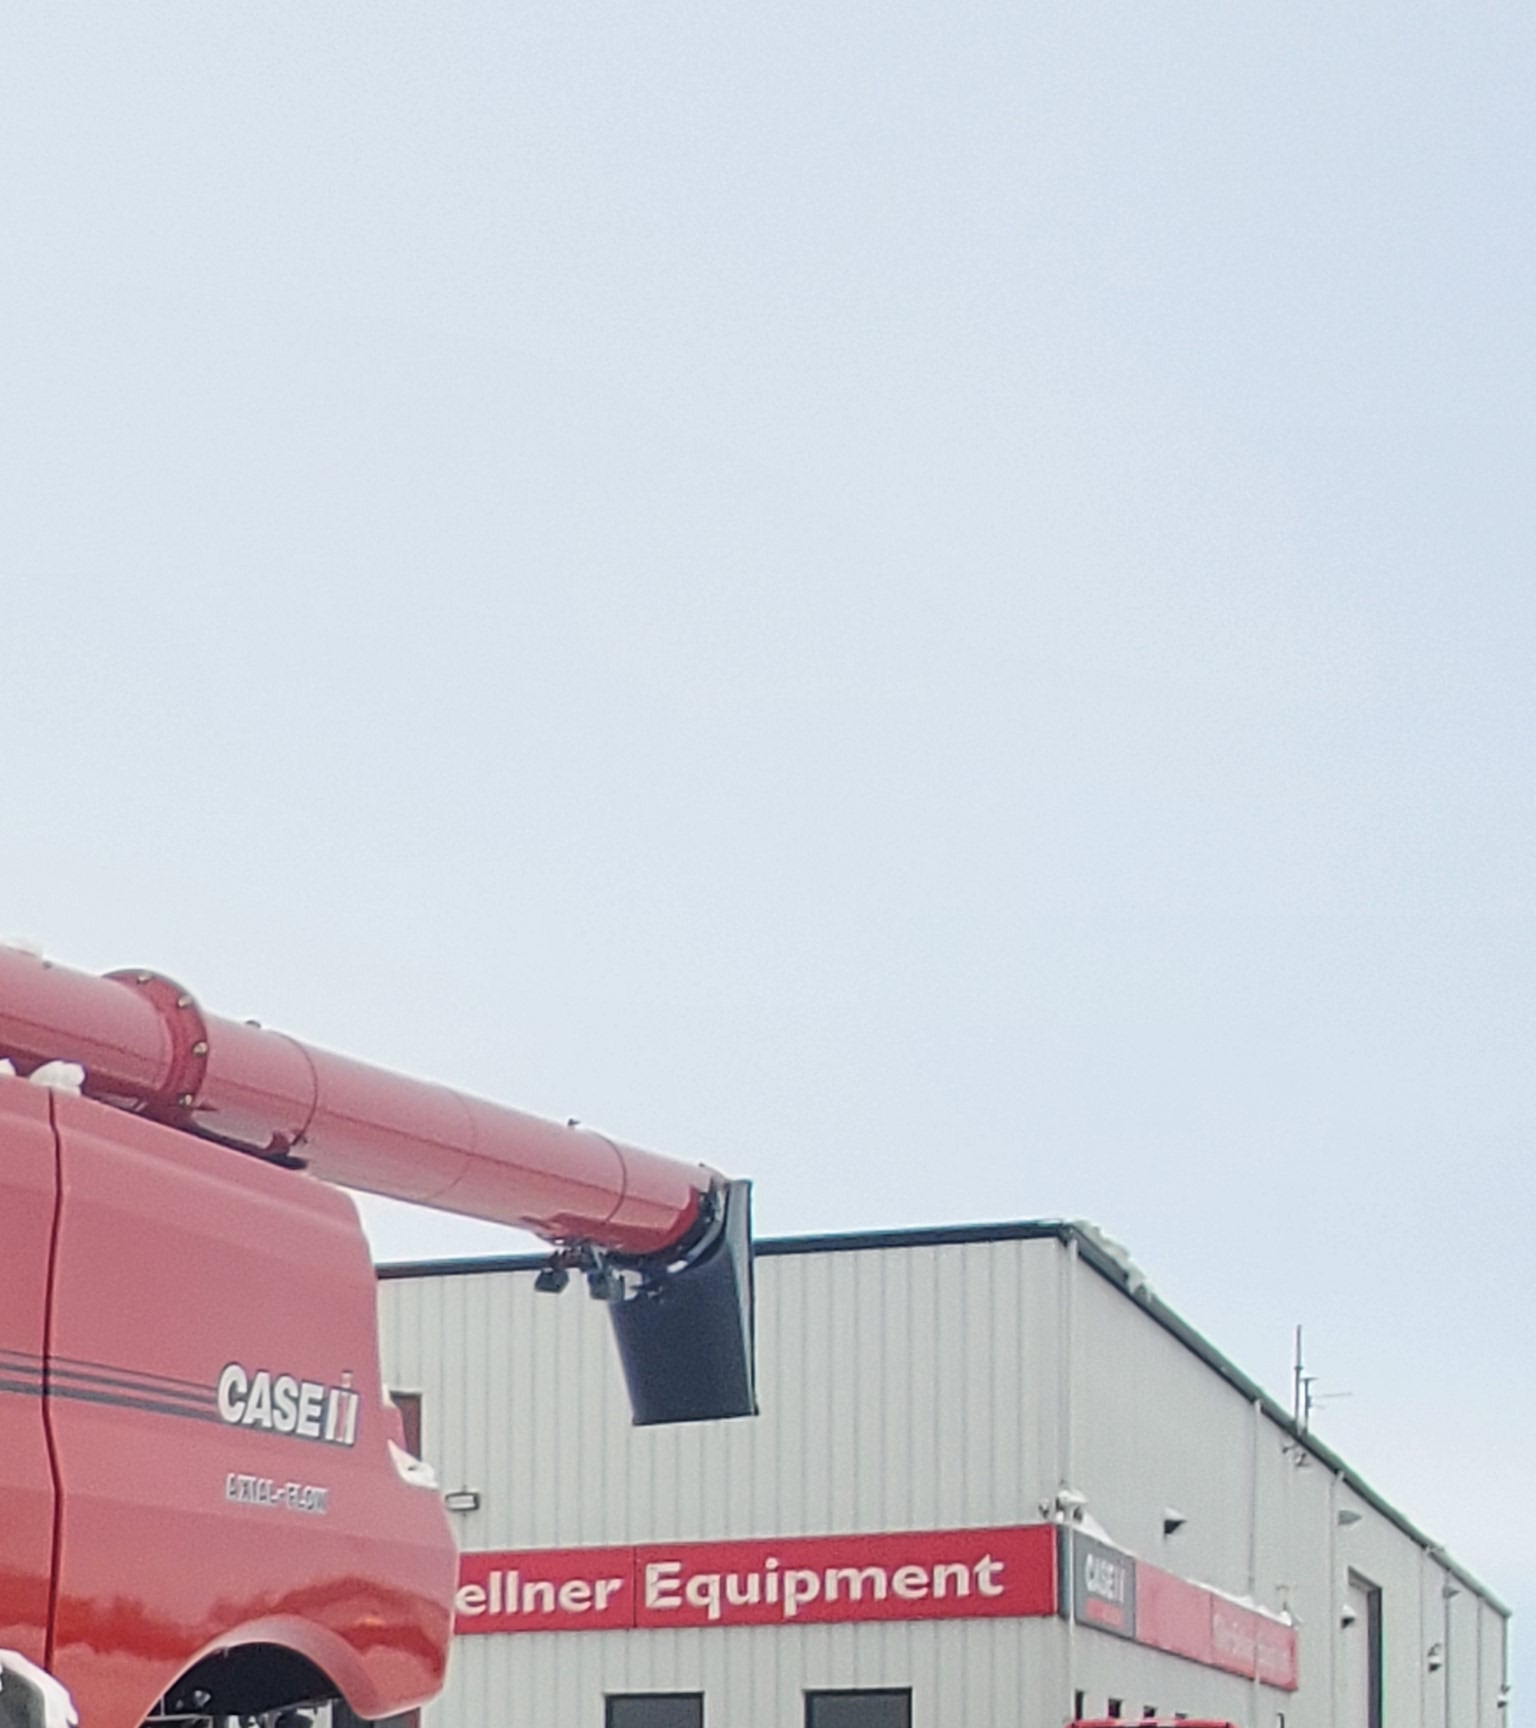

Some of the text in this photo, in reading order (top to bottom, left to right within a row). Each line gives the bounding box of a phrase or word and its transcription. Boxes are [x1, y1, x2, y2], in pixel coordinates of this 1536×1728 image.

[217, 1362, 325, 1438] CASE
[454, 1553, 1005, 1620] ellner Equipment
